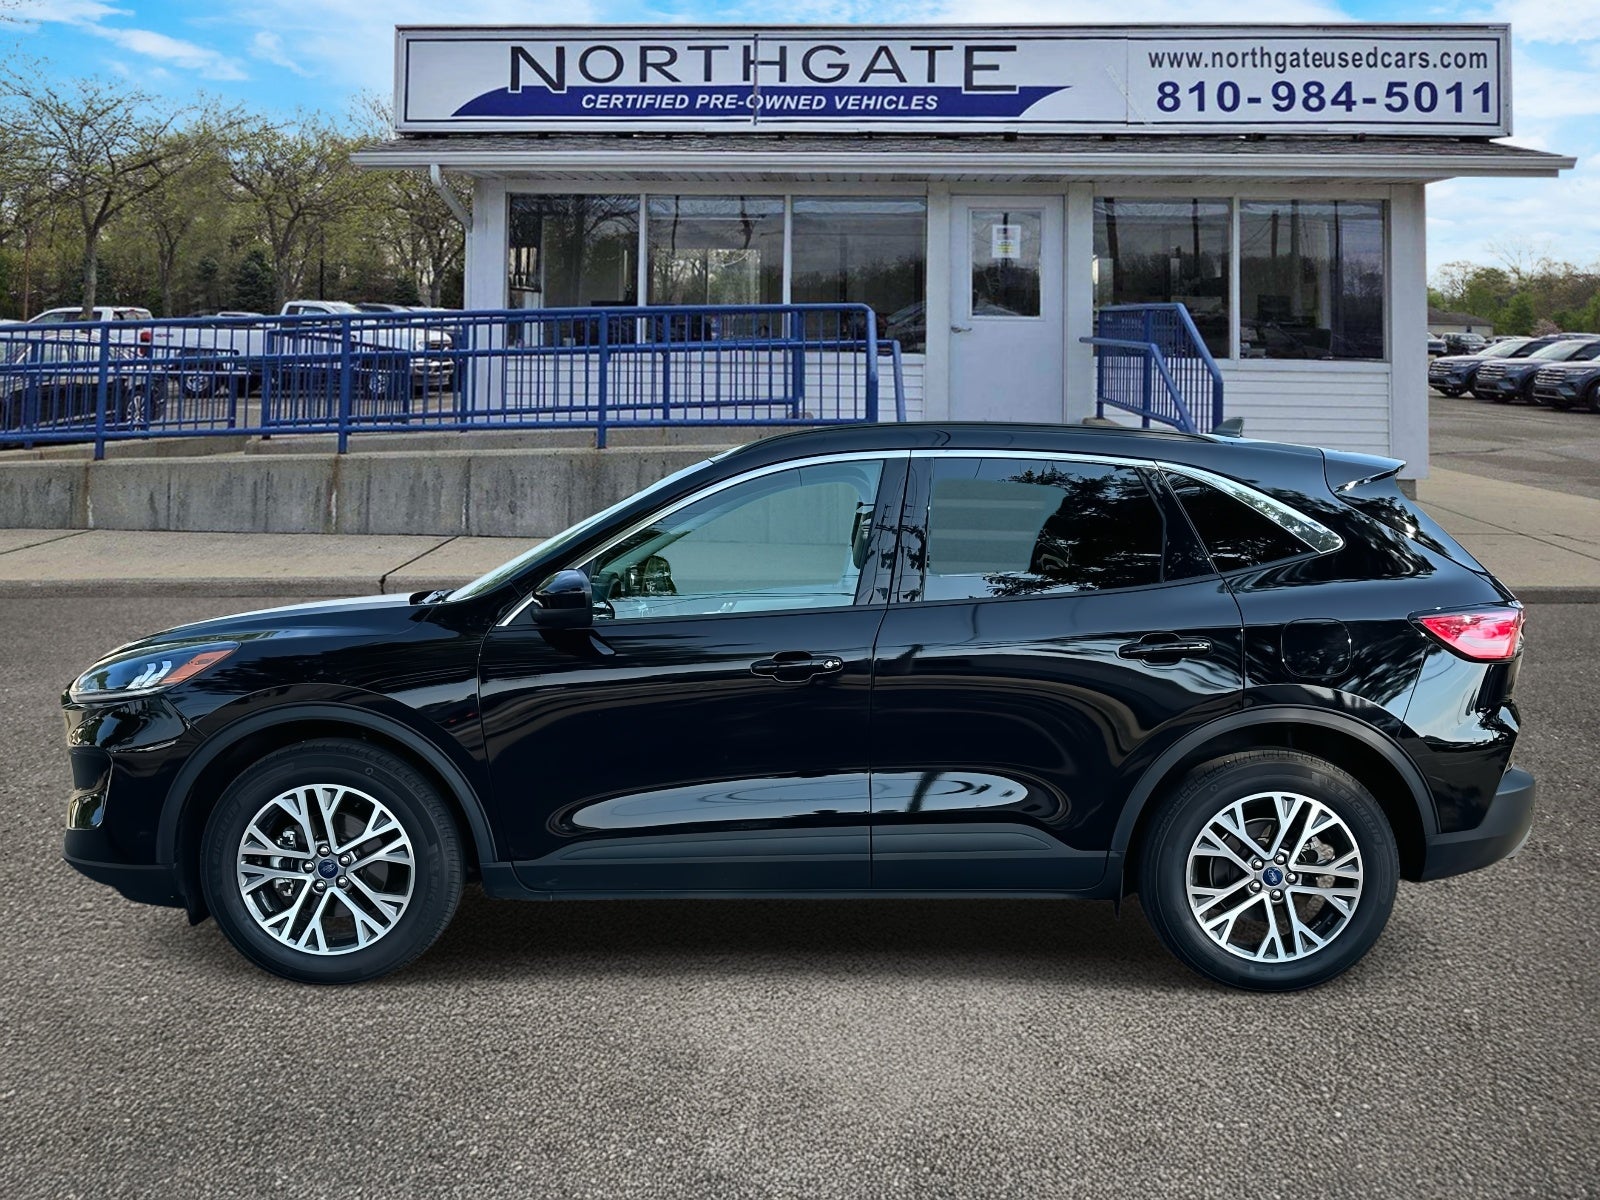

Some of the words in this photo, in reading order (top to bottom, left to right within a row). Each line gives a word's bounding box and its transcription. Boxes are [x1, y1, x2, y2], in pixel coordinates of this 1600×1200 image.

[510, 45, 1017, 92] NORTHGATE
[1149, 46, 1488, 74] www.northgateusedcars.com
[581, 94, 690, 110] CERTIFIED
[695, 94, 827, 111] PRE-OWNED
[834, 95, 939, 111] VEHICLES
[1156, 80, 1491, 113] 810-984-5011
